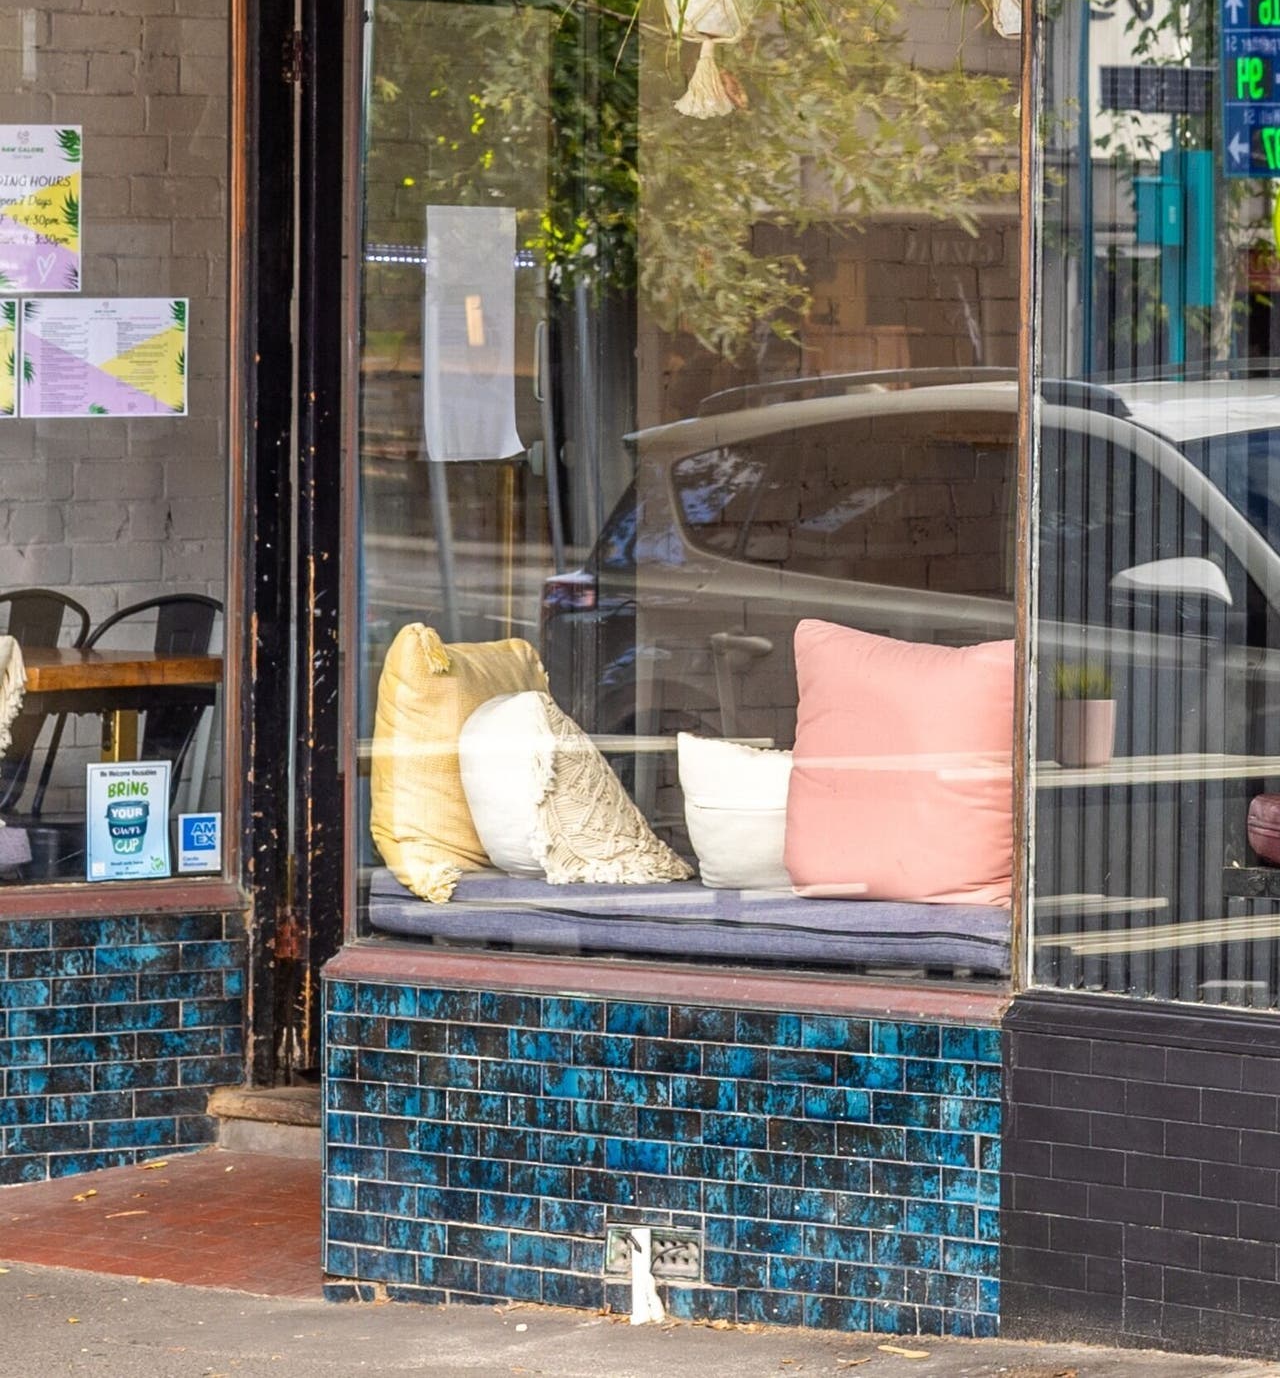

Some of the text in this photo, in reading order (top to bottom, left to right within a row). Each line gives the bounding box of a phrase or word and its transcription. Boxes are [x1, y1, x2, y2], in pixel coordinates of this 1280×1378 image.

[30, 175, 71, 187] HOURS
[111, 807, 144, 818] YOUR
[191, 822, 216, 834] AM
[193, 833, 216, 846] EX
[114, 838, 140, 854] CUP
